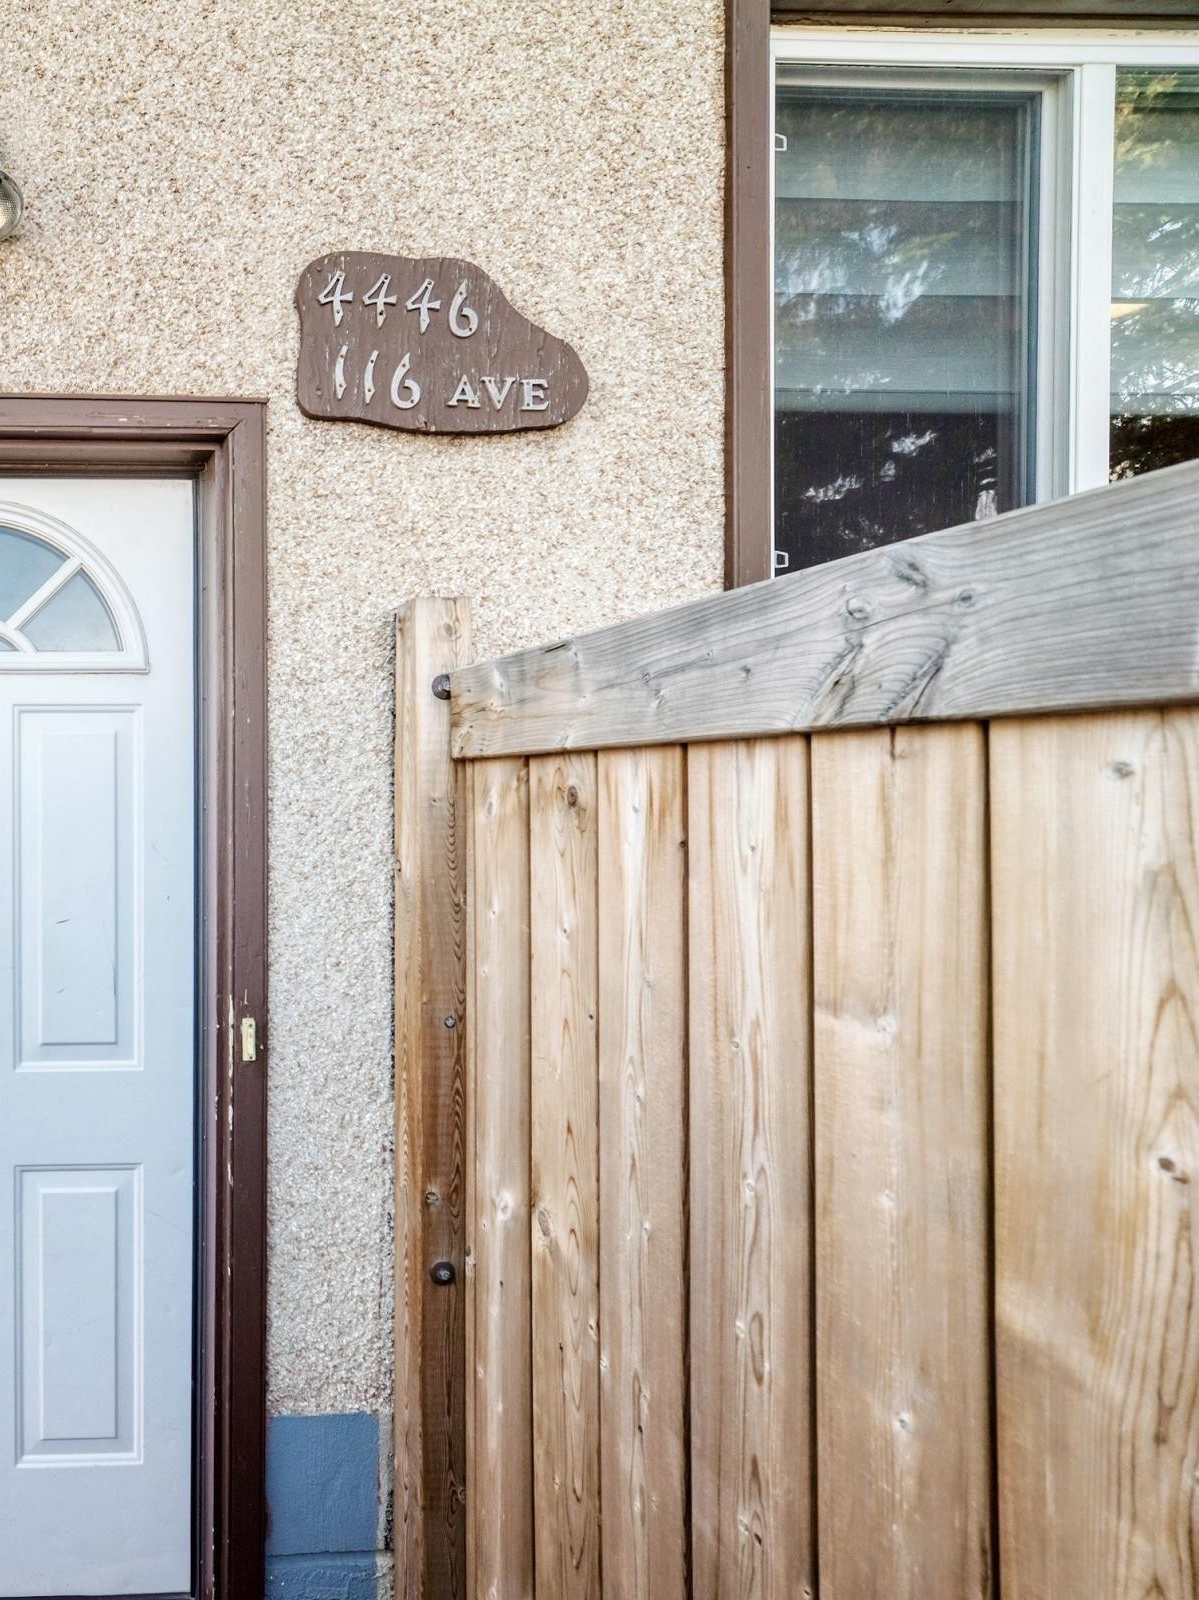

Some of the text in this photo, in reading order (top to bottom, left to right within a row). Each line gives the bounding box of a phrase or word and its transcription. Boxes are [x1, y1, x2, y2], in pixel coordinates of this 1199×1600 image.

[317, 271, 479, 338] 4446
[335, 345, 550, 411] 116 AVE
